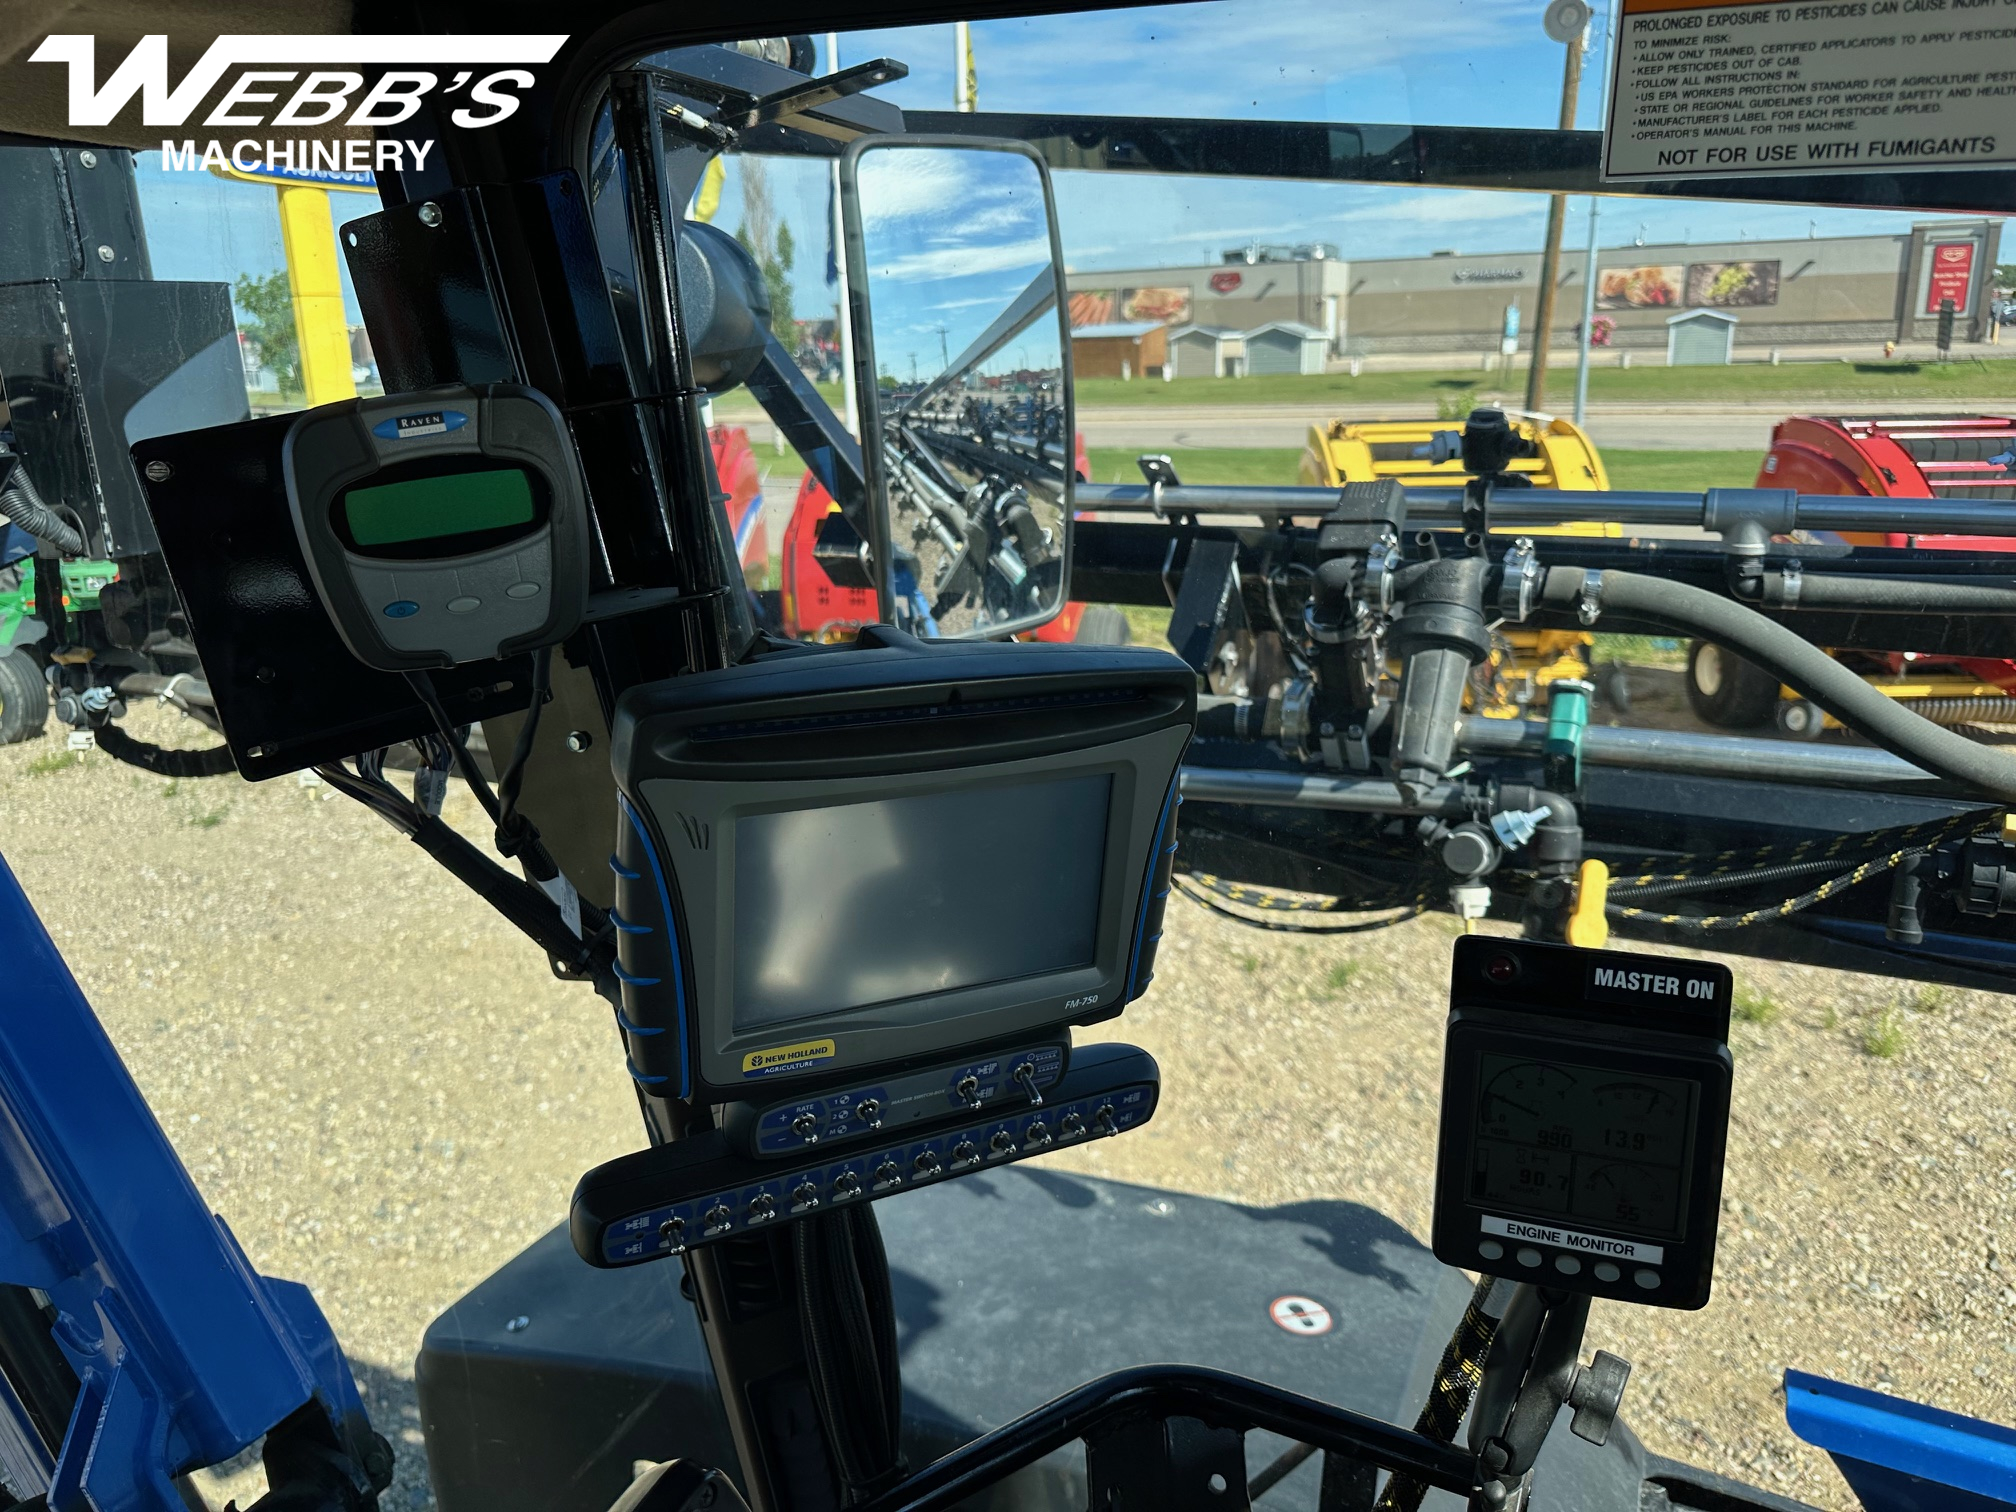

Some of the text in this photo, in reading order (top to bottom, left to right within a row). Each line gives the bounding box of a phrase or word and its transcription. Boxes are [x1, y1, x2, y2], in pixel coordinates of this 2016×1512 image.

[1633, 16, 1702, 33] PROLONGED
[1707, 10, 1770, 28] EXPOSURE
[1776, 9, 1790, 23] TO
[1795, 4, 1867, 21] PESTICIDES
[1872, 1, 1898, 15] CAN
[1903, 0, 1946, 13] CAUSE
[1634, 34, 1732, 50] TO MINIMIZE RISK:
[1639, 52, 1674, 62] ALLOW
[1678, 49, 1705, 60] ONLY
[1709, 46, 1757, 58] TRAINED,
[1761, 42, 1816, 54] CERTIFIED
[1820, 36, 1896, 50] APPLICATORS
[1901, 35, 1916, 45] TO
[1920, 32, 1955, 43] APPLY
[1637, 56, 1802, 76] KEEP PESTICIDES OUT OF CAB.
[1636, 70, 1800, 89] FOLLOW ALL INSTRUCTIONS IN:
[1640, 71, 2016, 102] US EPA WORKERS PROTECTION STANDARD FOR AGRICULTURE PEST
[1639, 105, 1669, 115] STATE
[1673, 104, 1688, 113] OR
[1692, 100, 1745, 112] REGIONAL
[1749, 97, 1812, 108] GUIDELINES
[1817, 95, 1840, 105] FOR
[1844, 91, 1893, 103] WORKER
[1898, 89, 1943, 101] SAFETY
[1947, 88, 1972, 98] AND
[1637, 103, 1943, 128] MANUFACTURER'S LABEL FOR EACH PESTICIDE APPLIED.
[1636, 121, 1857, 141] OPERATOR'S MANUAL FOR THIS MACHINE.
[1657, 136, 1996, 166] NOT FOR USE WITH FUMIGANTS
[1594, 967, 1715, 1000] MASTER ON
[1064, 994, 1099, 1010] FM-750
[765, 1046, 828, 1064] NEW HOLLAND
[764, 1060, 813, 1074] AGRICULTURE
[796, 1104, 814, 1113] RATE
[1033, 1114, 1042, 1122] 10
[1506, 1223, 1635, 1257] ENGINE MONITOR
